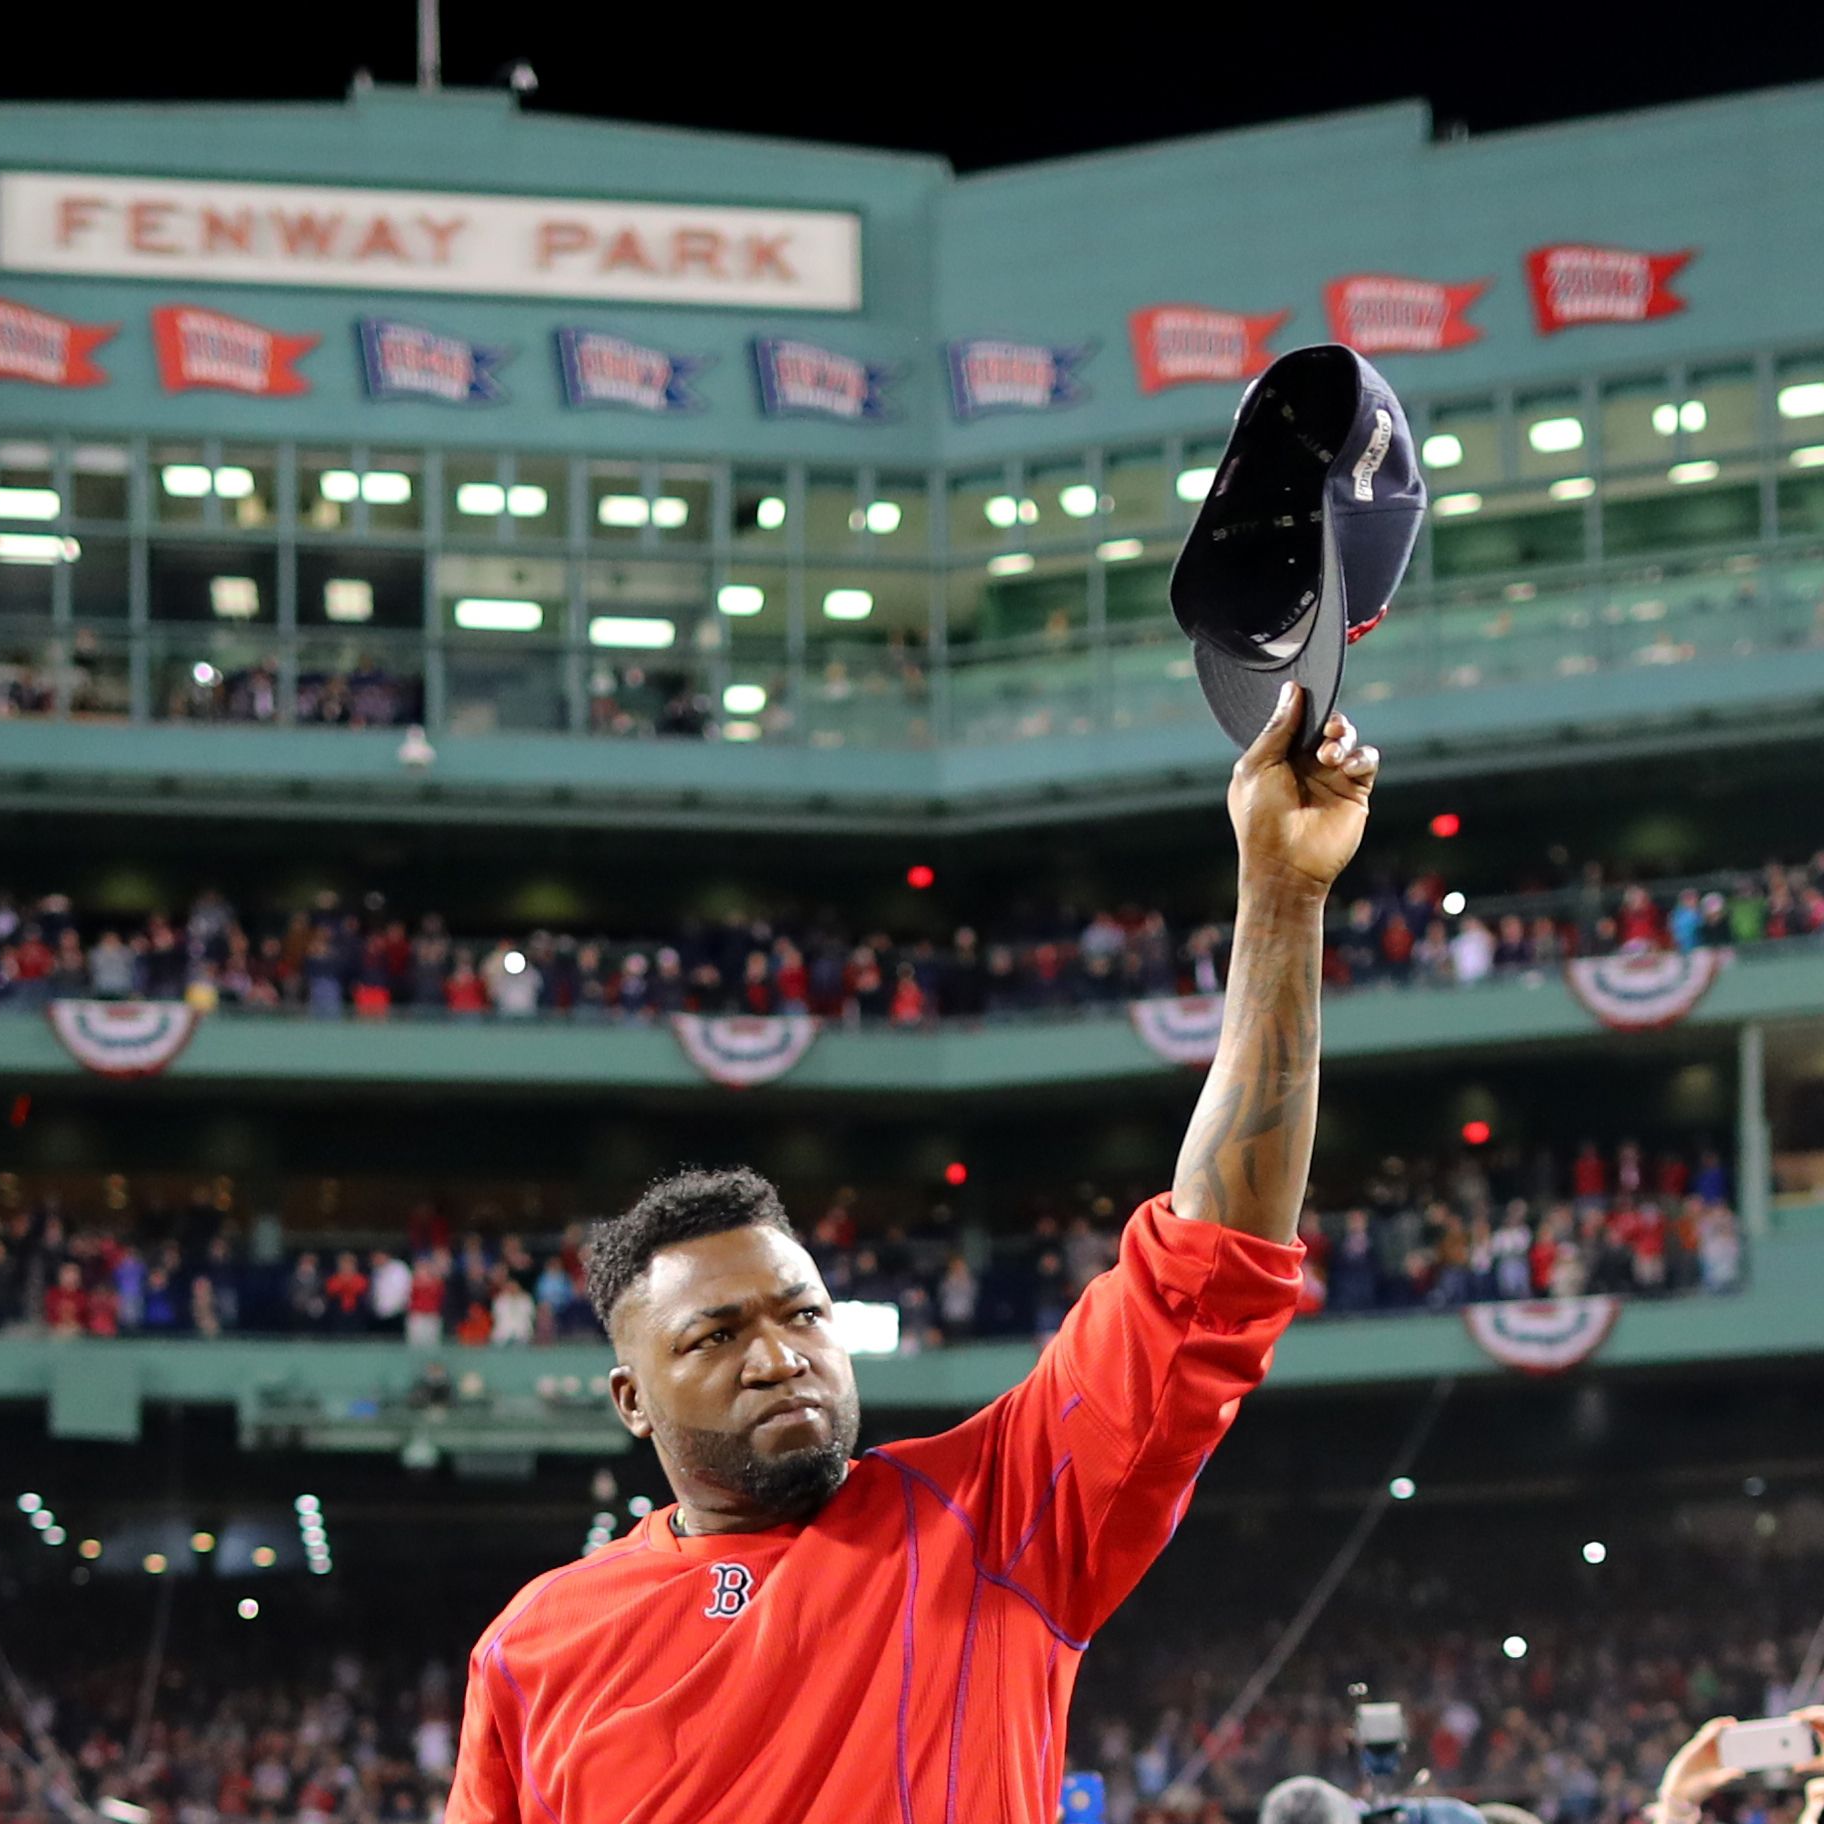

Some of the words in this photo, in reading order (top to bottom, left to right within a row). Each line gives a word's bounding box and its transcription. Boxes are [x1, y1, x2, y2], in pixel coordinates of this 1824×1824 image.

[57, 199, 469, 267] FENWAY
[539, 222, 801, 283] PARK
[704, 1563, 755, 1619] B
